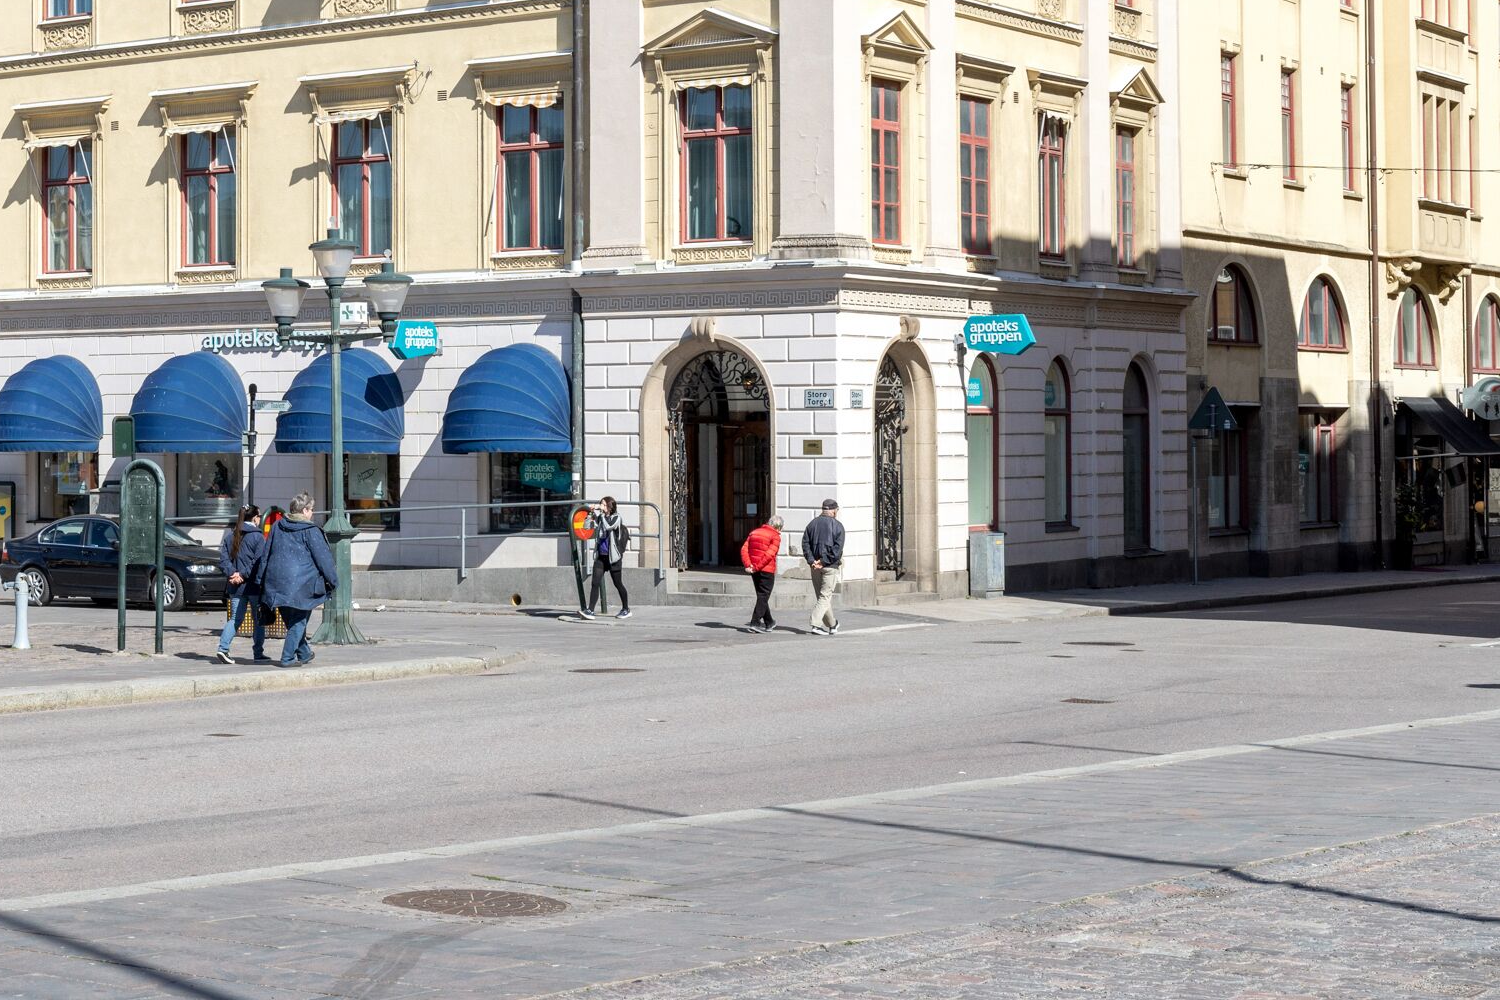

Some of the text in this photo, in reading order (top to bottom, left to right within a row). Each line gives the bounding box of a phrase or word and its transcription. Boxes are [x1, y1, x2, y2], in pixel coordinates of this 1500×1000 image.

[405, 326, 434, 338] apoteks
[970, 320, 1019, 333] apoteks
[404, 338, 436, 349] gruppen
[969, 332, 1023, 345] gruppen
[807, 398, 831, 406] Torgt
[524, 463, 555, 474] apoteks
